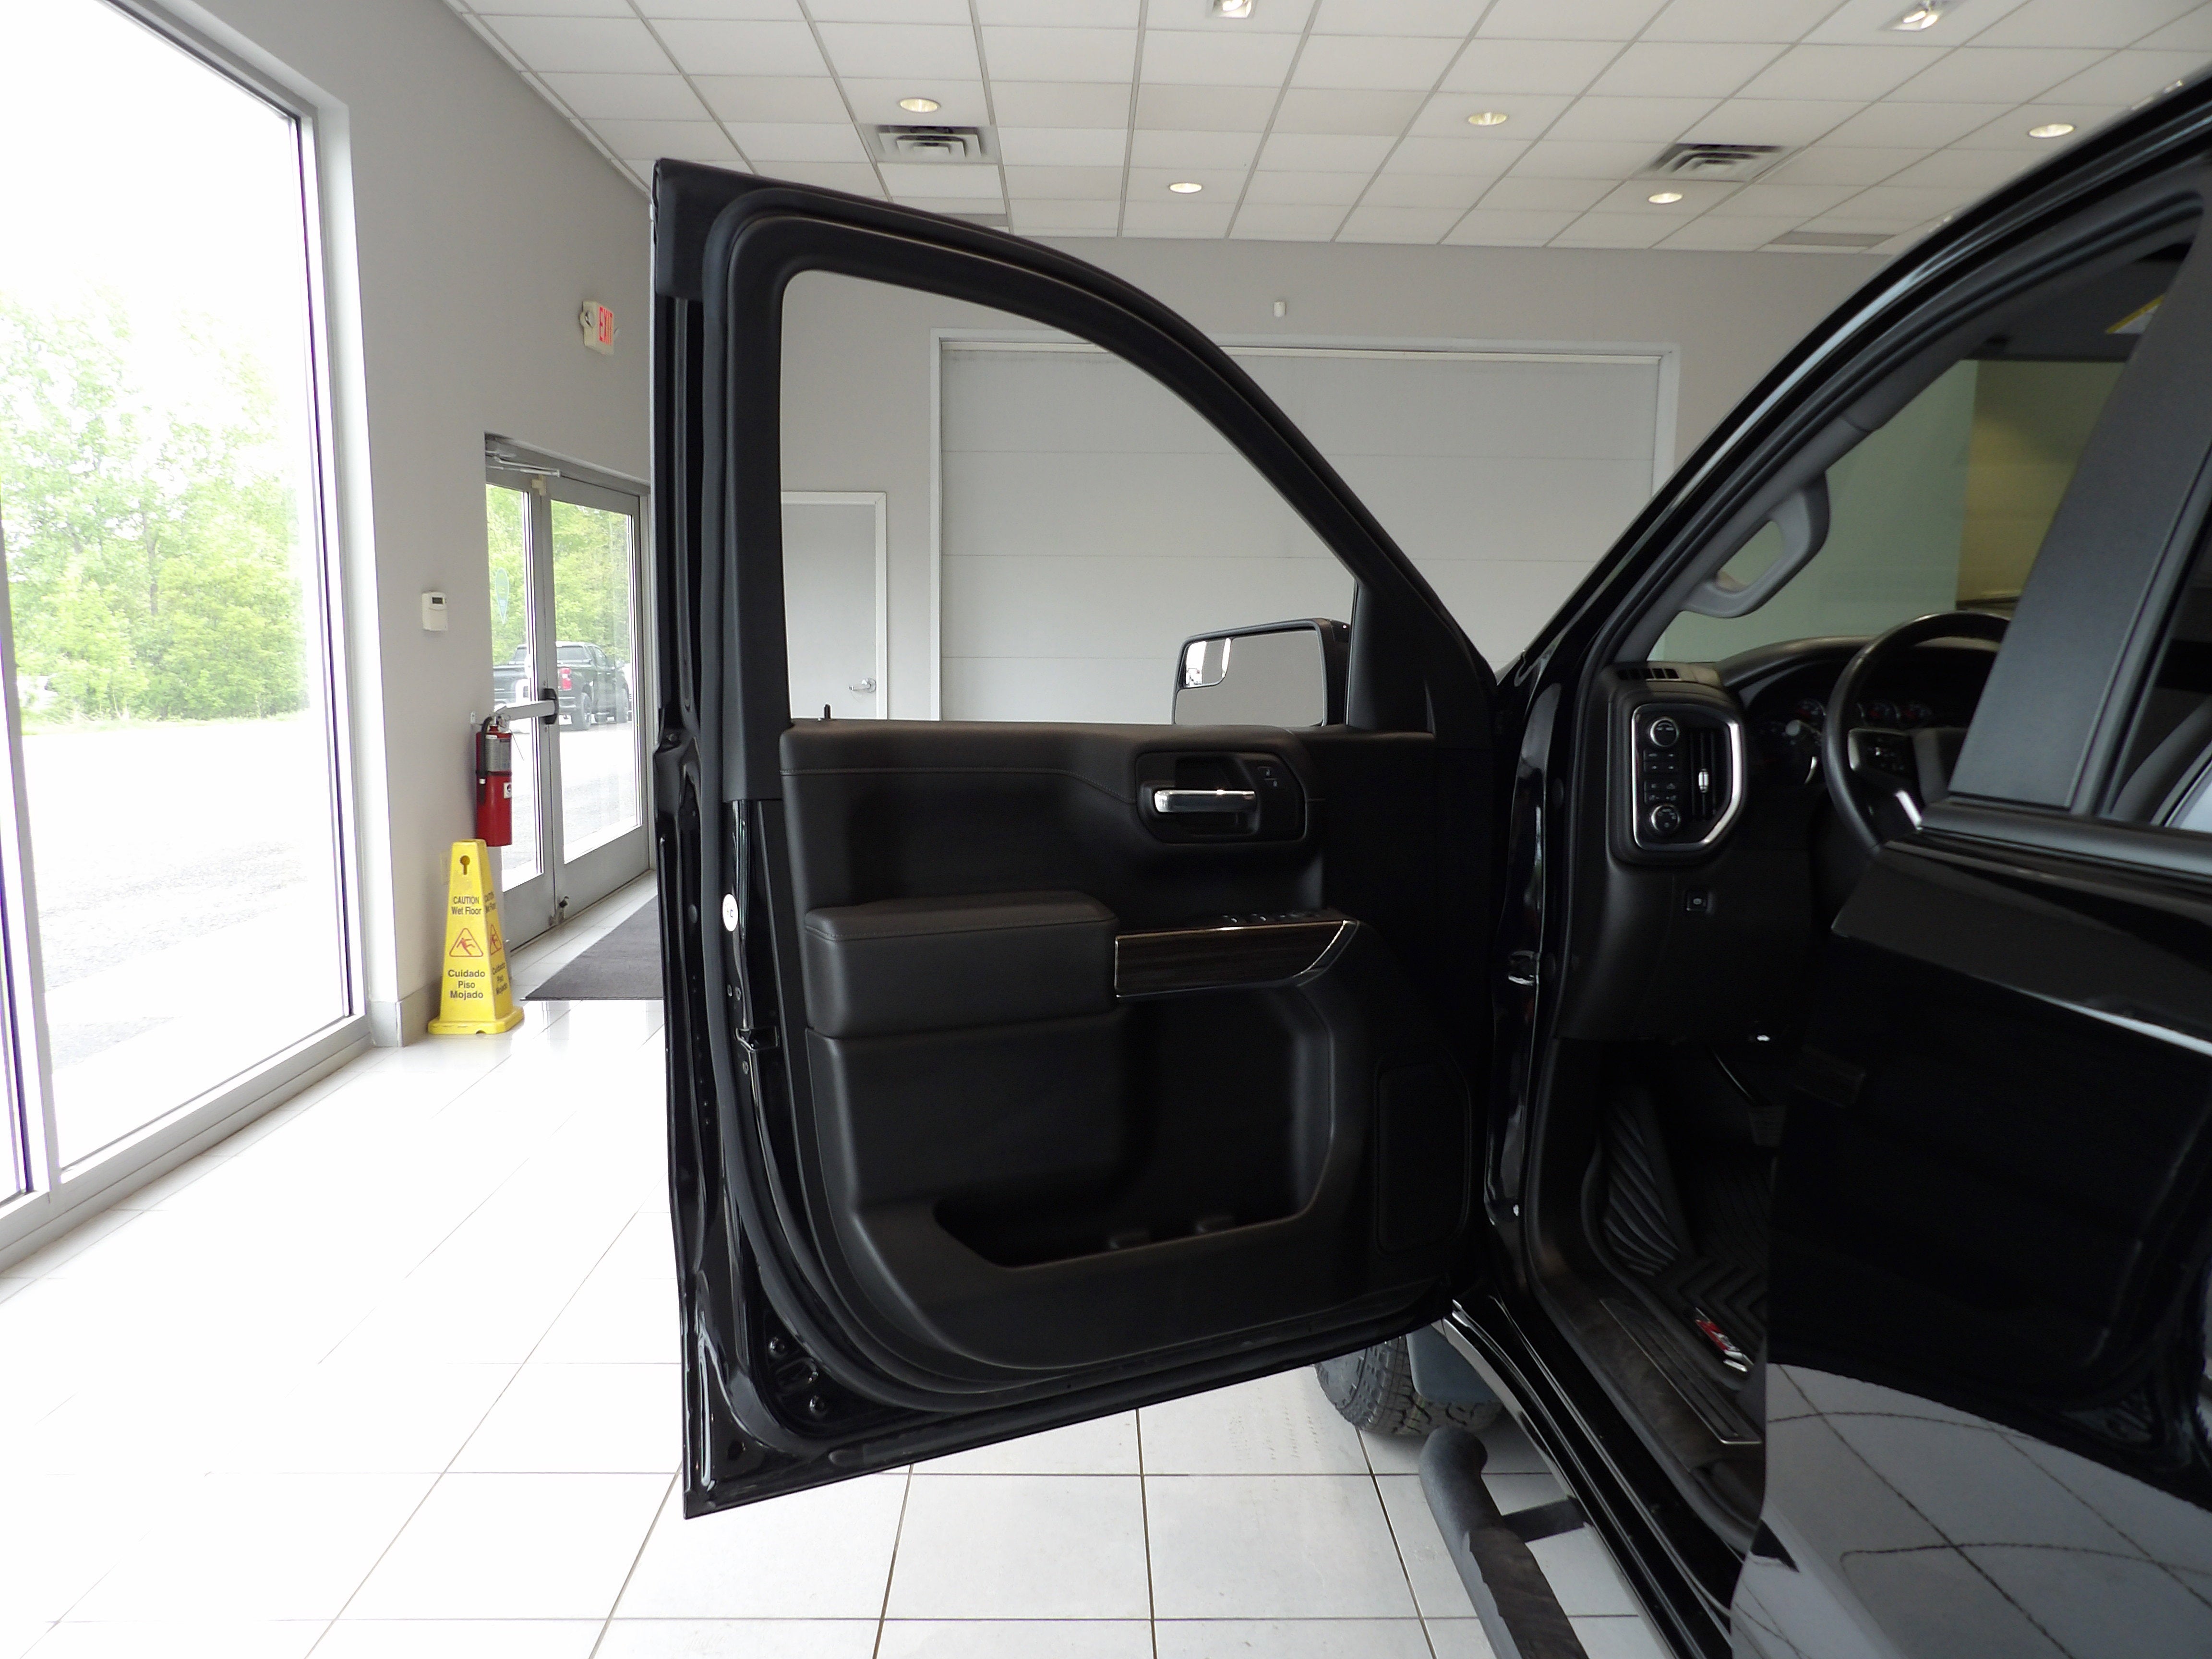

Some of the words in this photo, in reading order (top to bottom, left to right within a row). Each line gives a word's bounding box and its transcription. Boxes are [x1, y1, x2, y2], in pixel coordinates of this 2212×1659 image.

[453, 896, 479, 904] CAUTION
[451, 906, 463, 914] Wet
[465, 906, 481, 914] Floor
[458, 980, 475, 988] Piso
[450, 990, 483, 1000] Mojado
